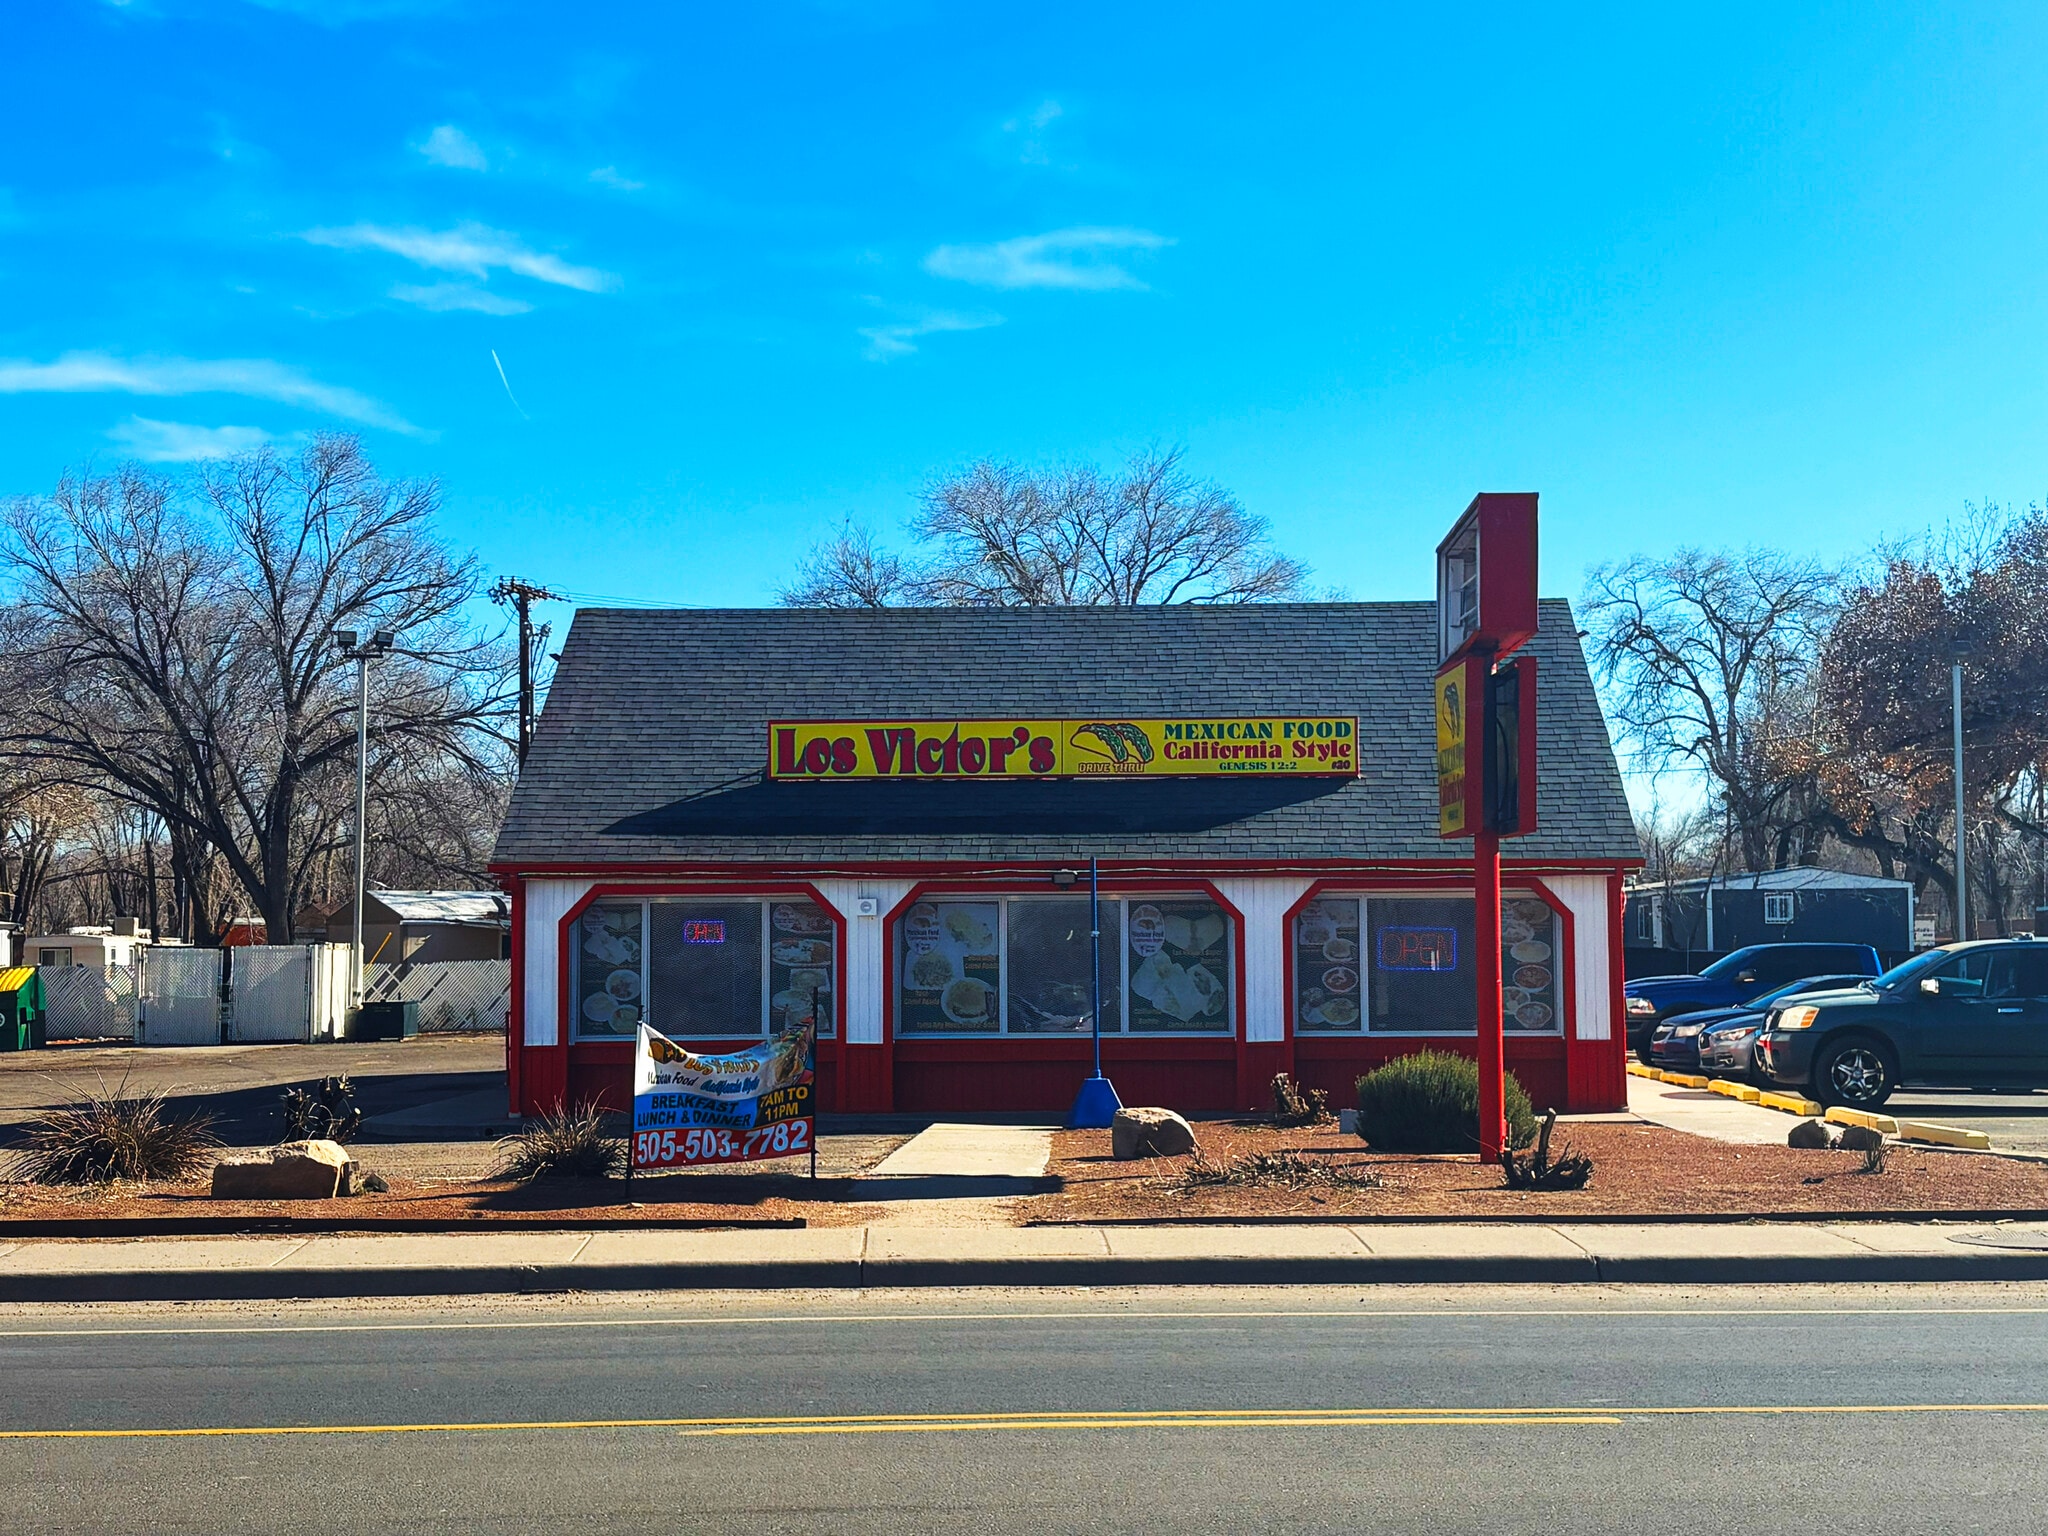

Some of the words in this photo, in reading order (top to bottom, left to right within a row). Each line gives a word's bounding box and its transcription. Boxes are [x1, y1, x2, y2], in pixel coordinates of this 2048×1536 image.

[1163, 722, 1273, 739] MEXICAN
[1283, 721, 1352, 738] FOOD
[776, 728, 858, 774] Los
[864, 722, 1056, 774] Victor's
[1163, 740, 1282, 759] California
[1292, 740, 1352, 762] Style
[1078, 763, 1111, 773] DRIVE
[1113, 763, 1145, 773] THRU
[1219, 762, 1267, 770] GENESIS
[1271, 761, 1297, 770] 12:2
[1382, 932, 1453, 965] OPEN
[672, 1071, 699, 1086] Food
[651, 1093, 740, 1114] BREAKFAST
[759, 1091, 785, 1109] 7AM
[788, 1087, 809, 1101] TO
[637, 1111, 676, 1127] LUNCH
[680, 1111, 690, 1124] &
[692, 1111, 752, 1127] DINNER
[765, 1102, 799, 1122] 11PM
[636, 1120, 809, 1164] 505-503-7782
